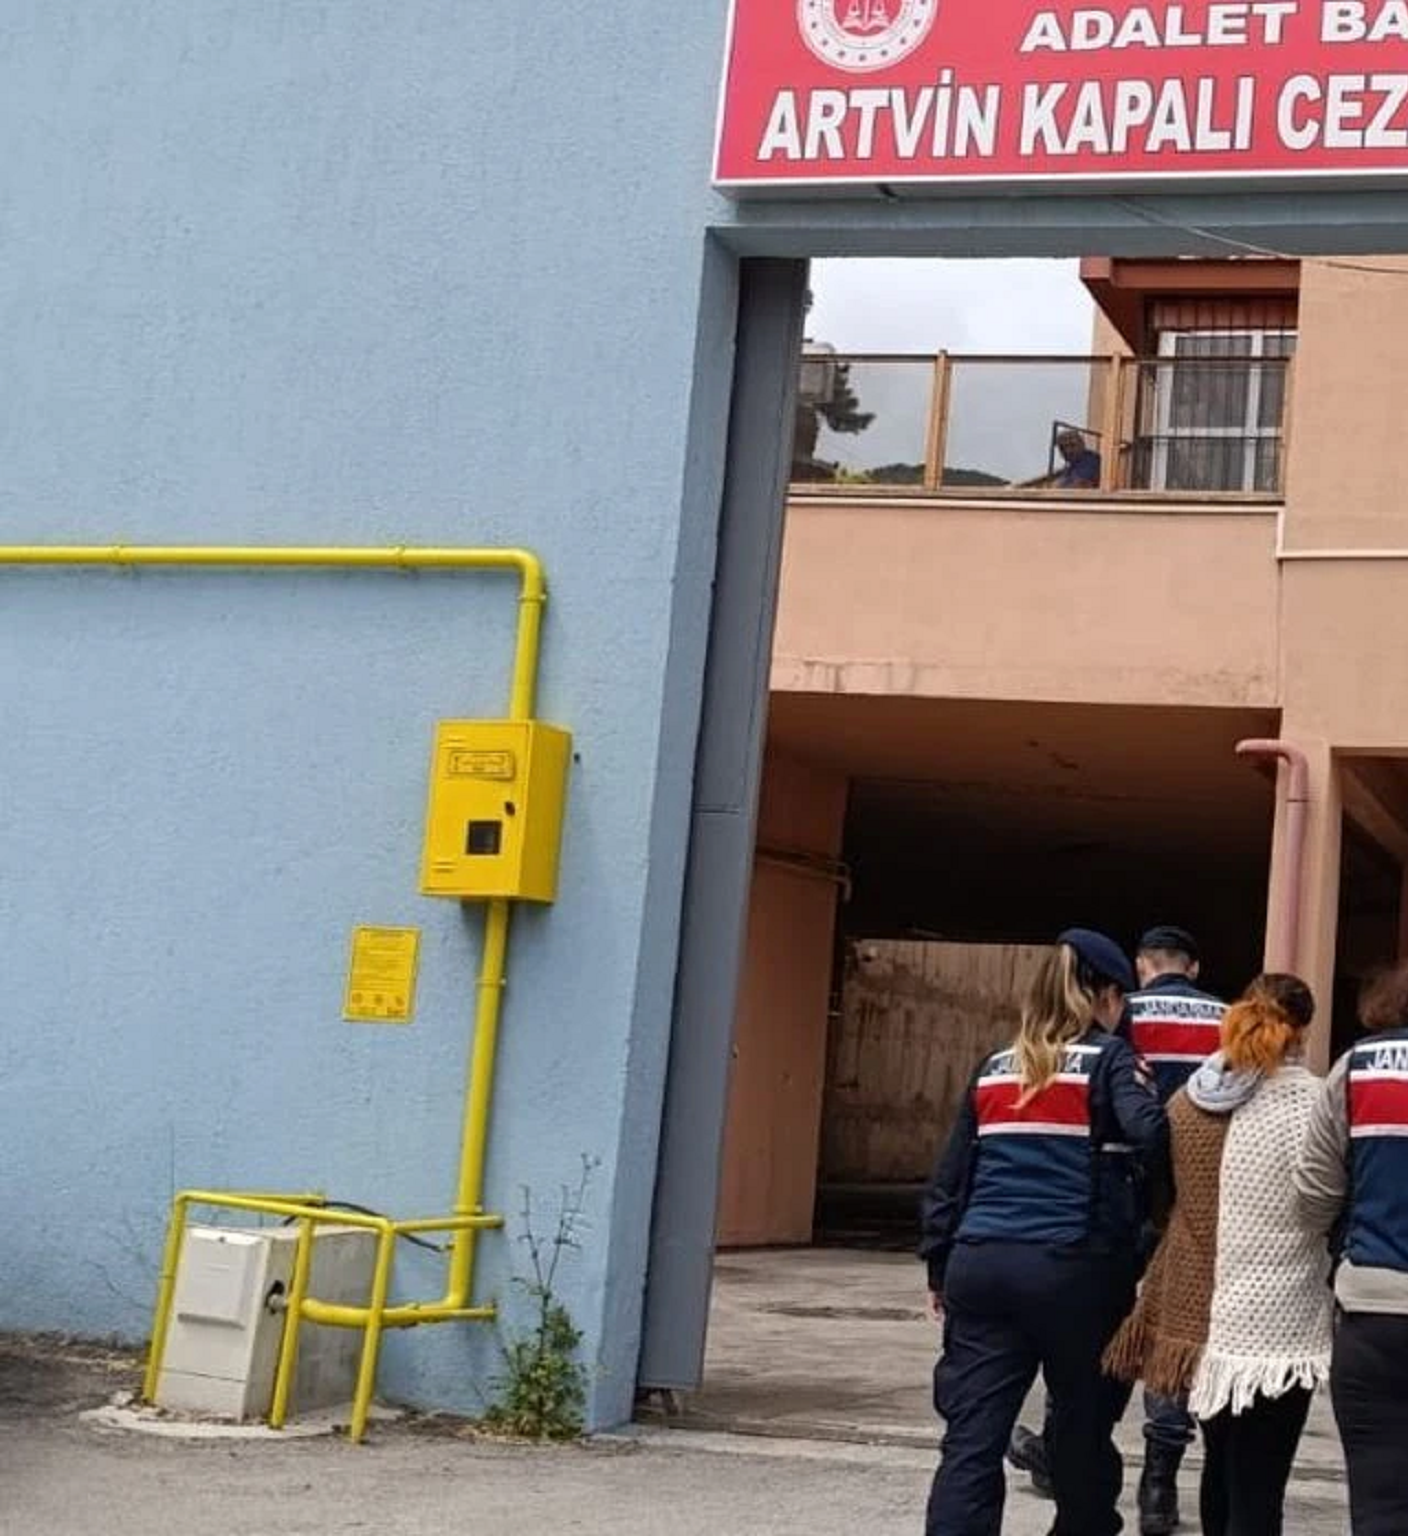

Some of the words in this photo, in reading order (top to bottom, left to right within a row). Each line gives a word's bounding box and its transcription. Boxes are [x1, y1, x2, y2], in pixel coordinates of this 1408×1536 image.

[1019, 1, 1297, 52] ADALET
[757, 68, 1000, 160] ARTVİN
[1019, 76, 1255, 156] KAPALI
